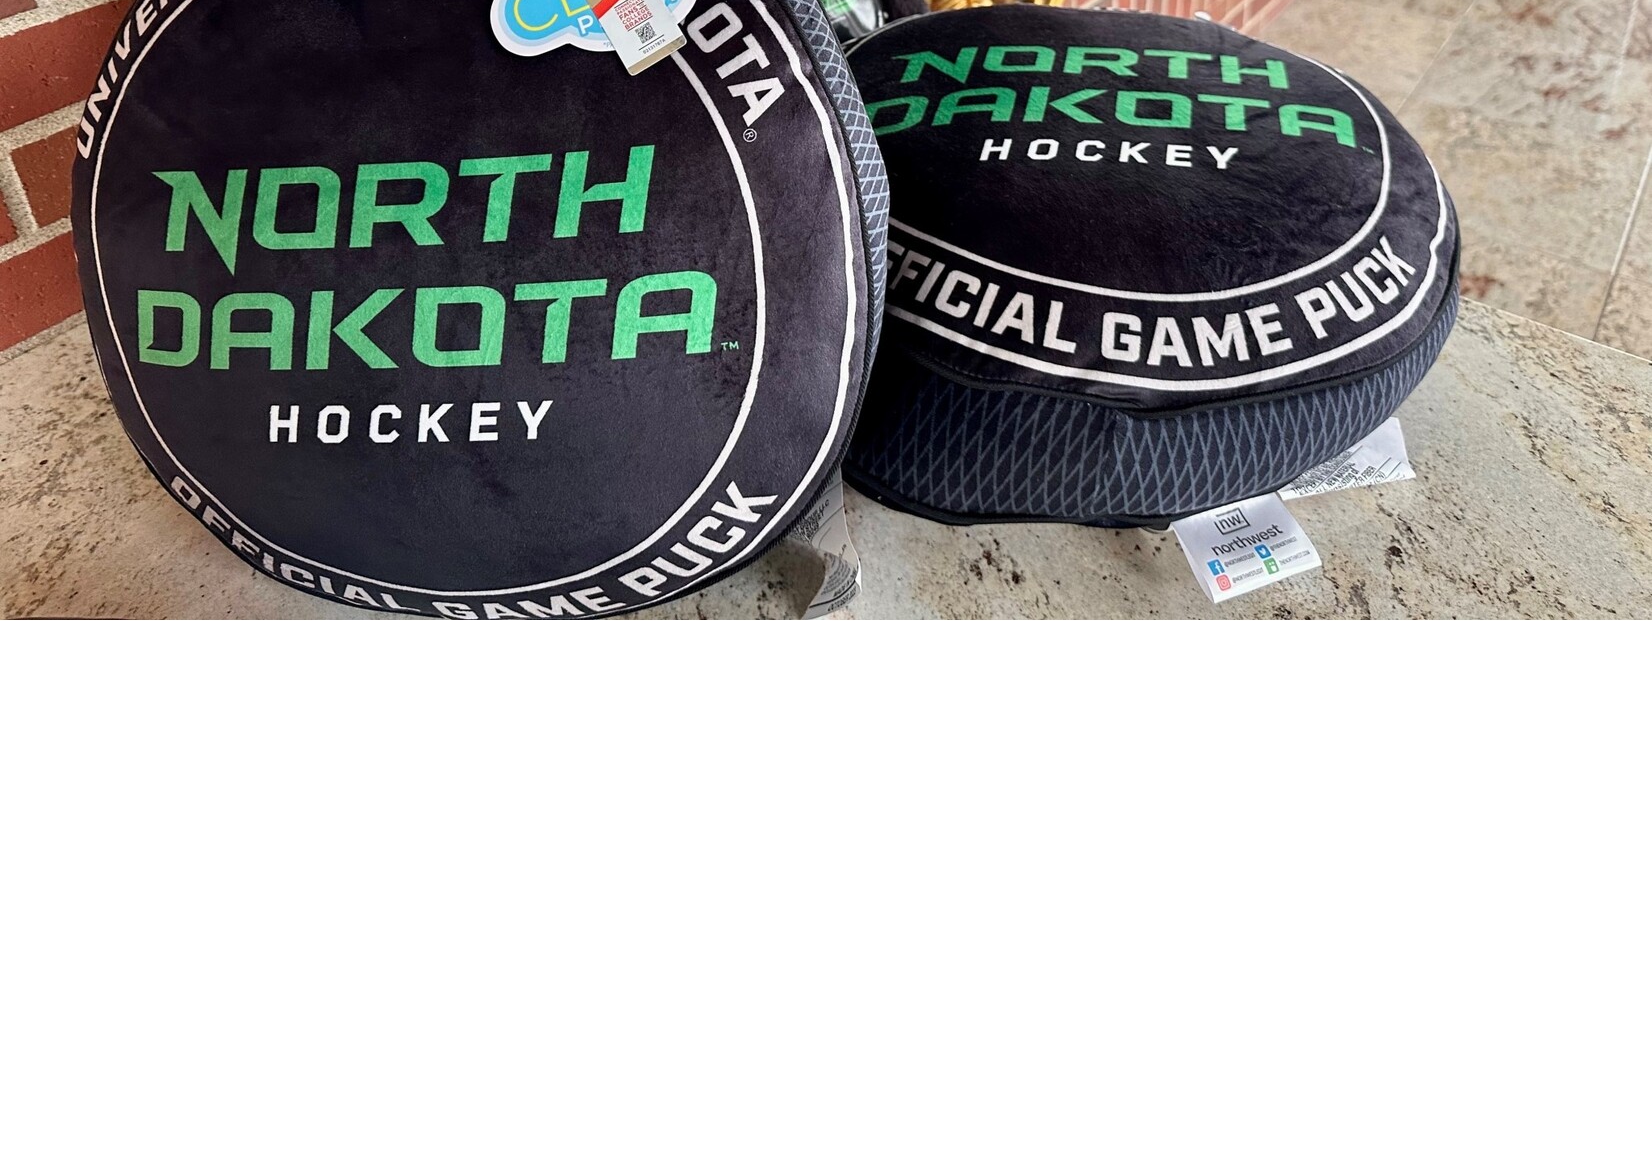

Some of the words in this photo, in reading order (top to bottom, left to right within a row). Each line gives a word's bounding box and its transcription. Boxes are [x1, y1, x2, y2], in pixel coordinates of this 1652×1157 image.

[619, 6, 639, 21] FANS
[622, 6, 650, 25] COLLEGE
[624, 11, 653, 31] BRANDS
[686, 1, 786, 128] OTA
[891, 46, 1290, 89] NORTH
[865, 86, 1357, 148] DAKOTA
[979, 138, 1239, 170] HOCKEY
[152, 145, 655, 277] NORTH
[137, 270, 718, 371] DAKOTA
[1101, 303, 1294, 369] GAME
[1295, 236, 1416, 340] PUCK
[269, 400, 554, 443] HOCKEY
[170, 476, 421, 612] OFFICIAL
[431, 586, 626, 619] GAME
[618, 481, 779, 597] PUCK
[1211, 524, 1284, 556] northwest
